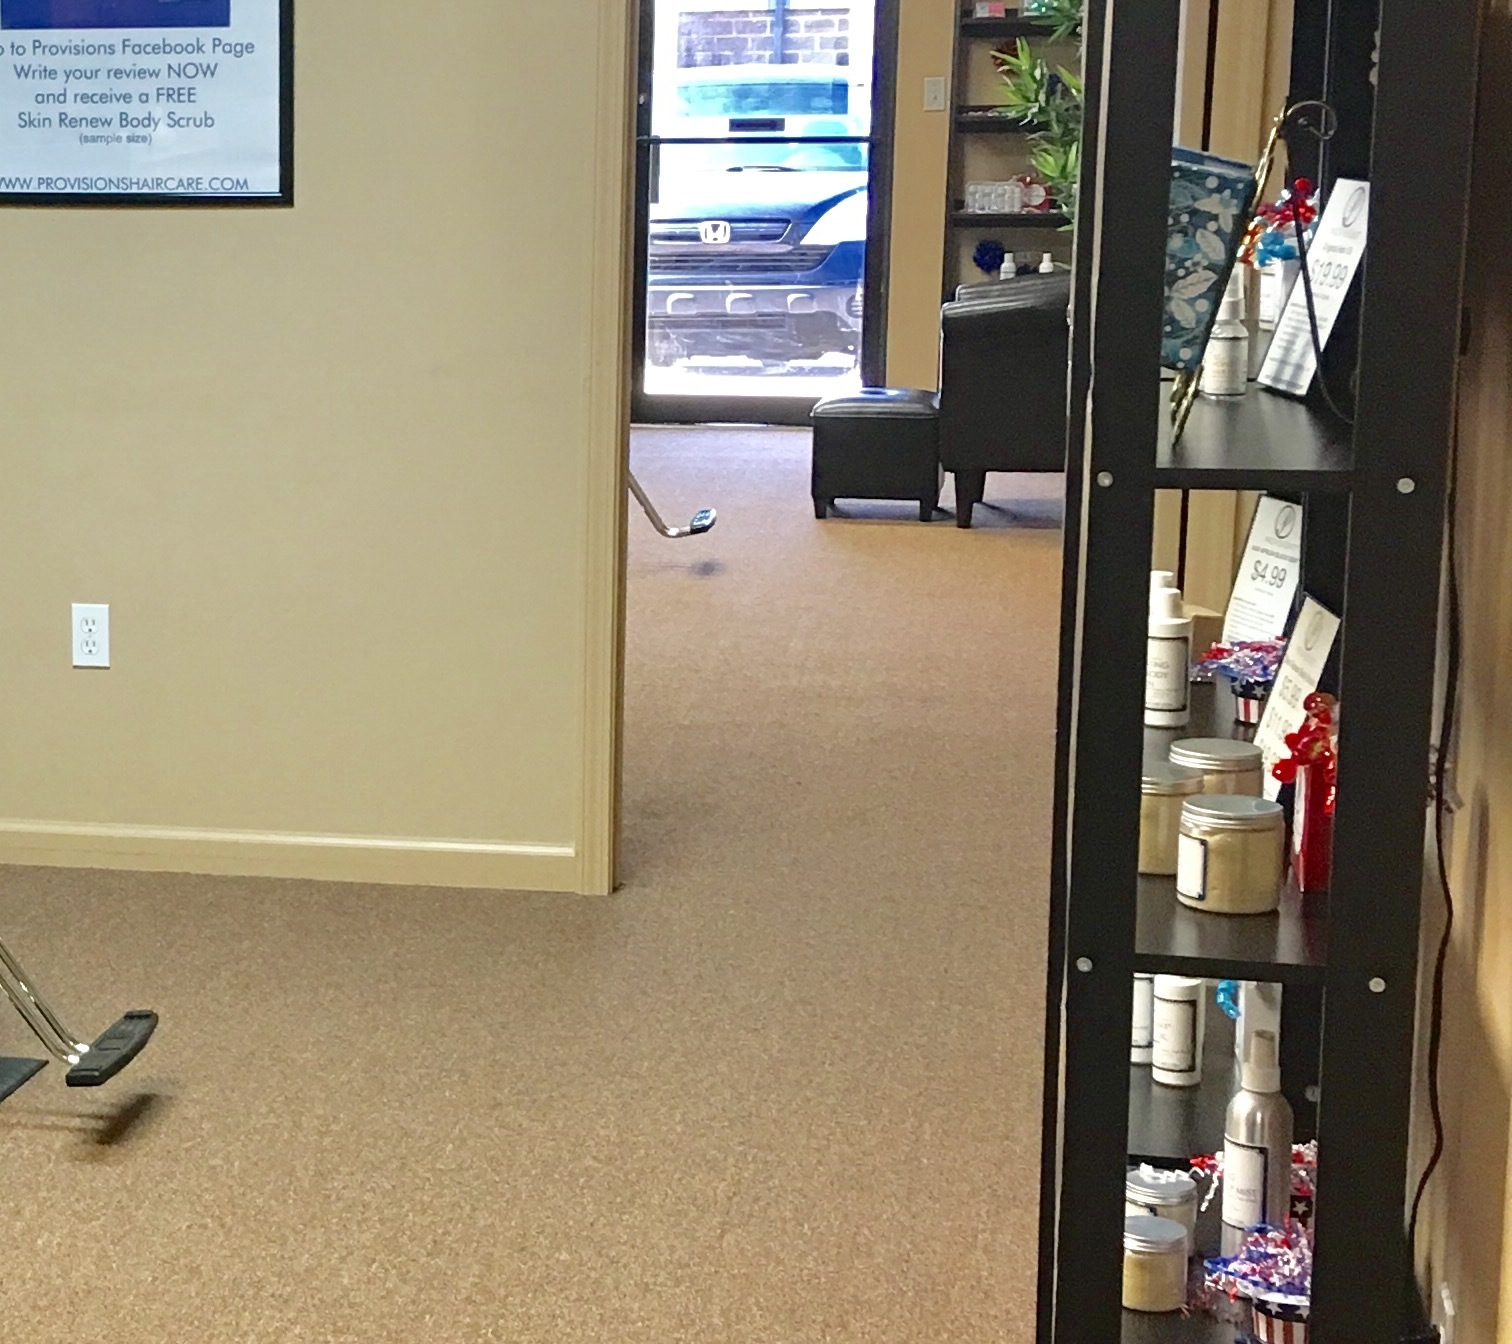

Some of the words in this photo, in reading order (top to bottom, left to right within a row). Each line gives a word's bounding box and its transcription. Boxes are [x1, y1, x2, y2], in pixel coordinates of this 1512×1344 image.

[10, 41, 26, 57] to
[32, 39, 115, 56] Provisions
[122, 37, 206, 55] Facebook
[213, 37, 255, 58] Page
[13, 63, 58, 80] Write
[63, 67, 101, 84] your
[106, 63, 161, 80] review
[167, 62, 218, 79] NOW
[34, 88, 67, 104] and
[73, 88, 133, 104] receive
[138, 92, 149, 104] a
[156, 87, 197, 104] FREE
[17, 112, 52, 129] Skin
[58, 112, 113, 129] Renew
[119, 111, 161, 132] Body
[166, 111, 215, 129] Scrub
[79, 133, 122, 146] (sample
[126, 133, 153, 146] size)
[1311, 258, 1349, 290] $19.99
[1251, 560, 1287, 589] $4.99
